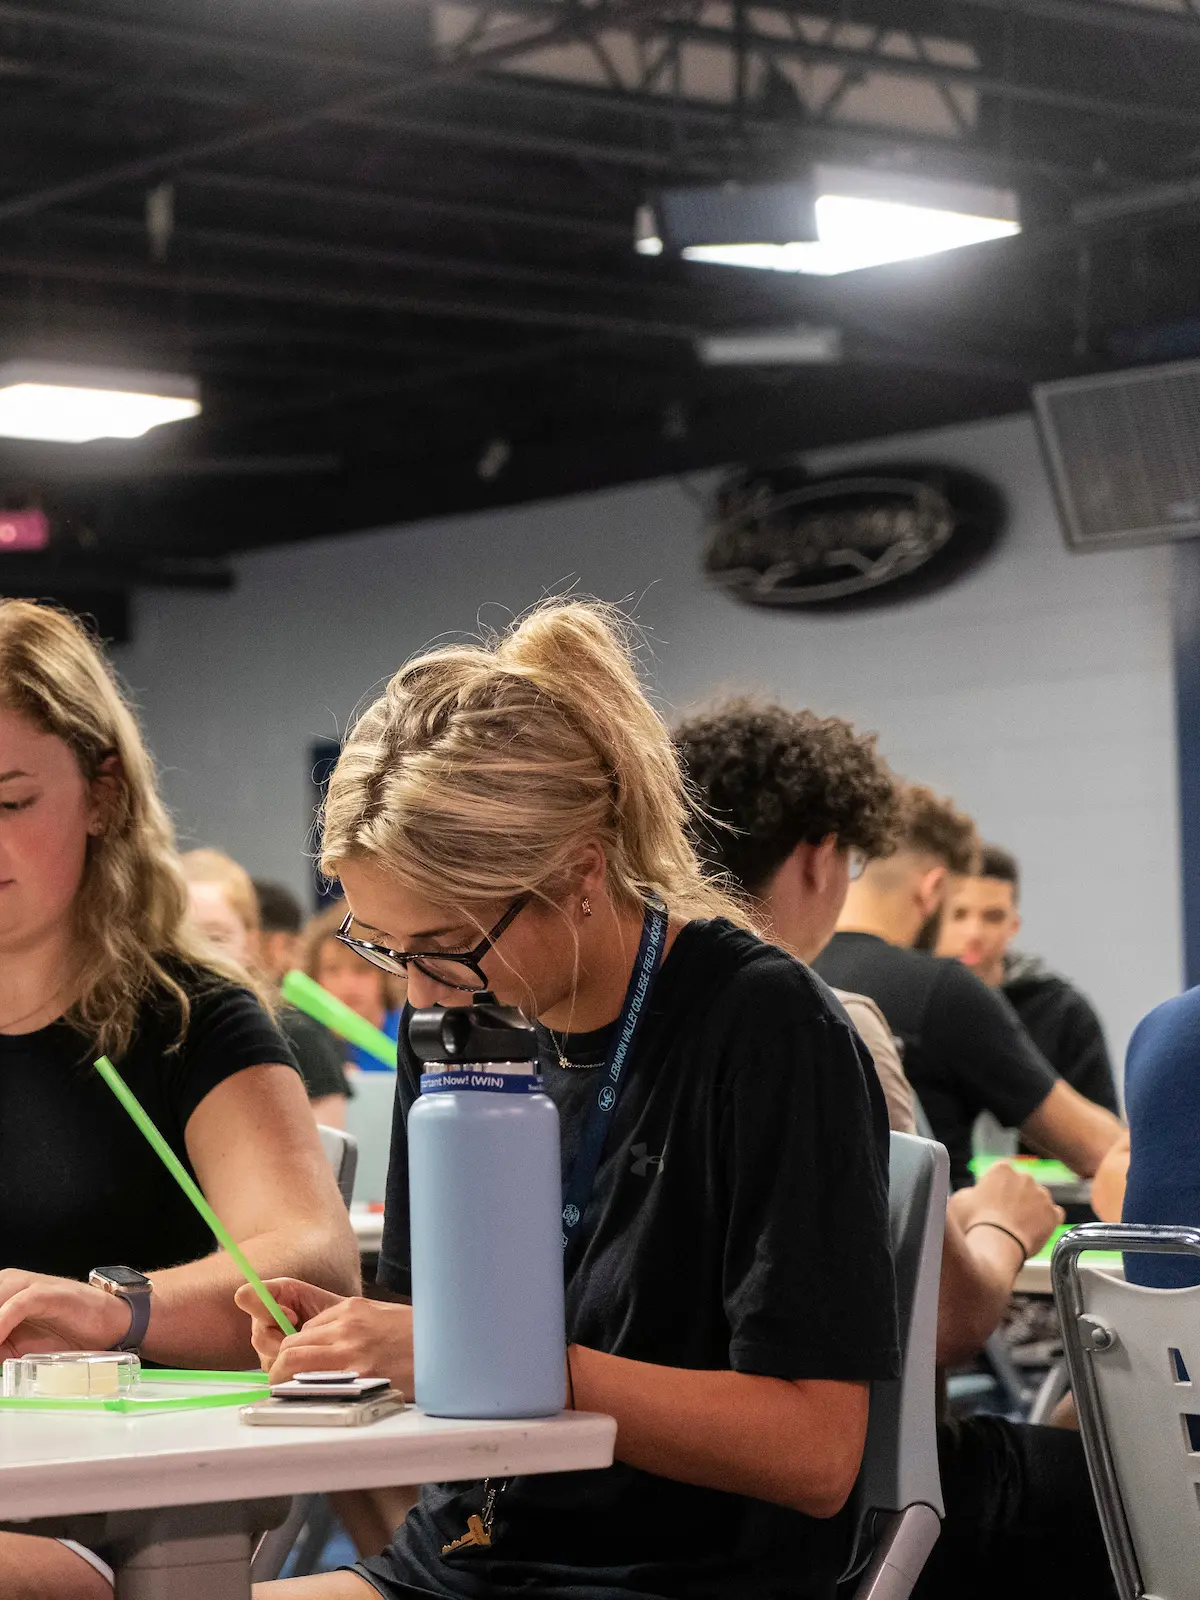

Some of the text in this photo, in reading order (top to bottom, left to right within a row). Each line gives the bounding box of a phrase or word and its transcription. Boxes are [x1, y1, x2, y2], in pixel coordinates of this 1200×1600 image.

[609, 1041, 629, 1082] LEBANON
[622, 1009, 638, 1042] VALLEY
[631, 971, 650, 1012] COLLEGE
[643, 946, 657, 973] FIELD
[443, 1075, 470, 1085] Now!
[471, 1075, 504, 1088] (WIN)
